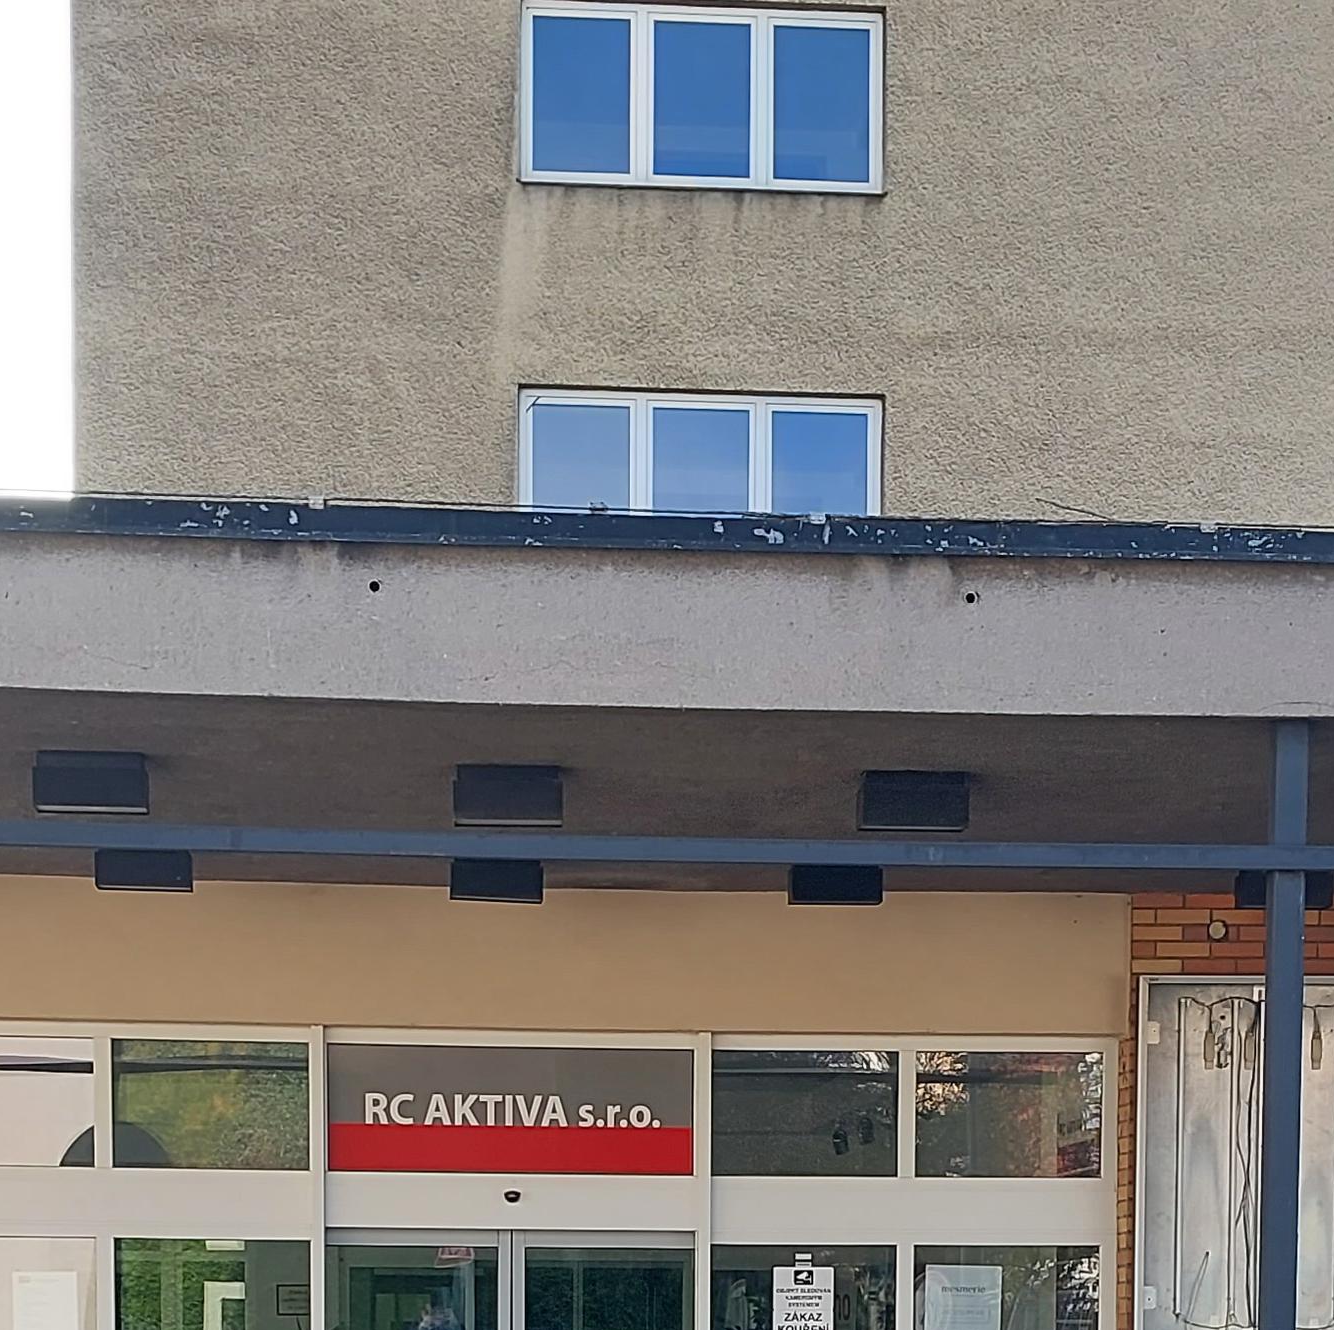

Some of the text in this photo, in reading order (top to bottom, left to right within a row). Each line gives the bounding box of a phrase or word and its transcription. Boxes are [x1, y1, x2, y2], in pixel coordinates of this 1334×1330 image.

[364, 1092, 662, 1129] RC AKTIVA s.r.o.
[784, 1310, 823, 1322] ZÁKAZ
